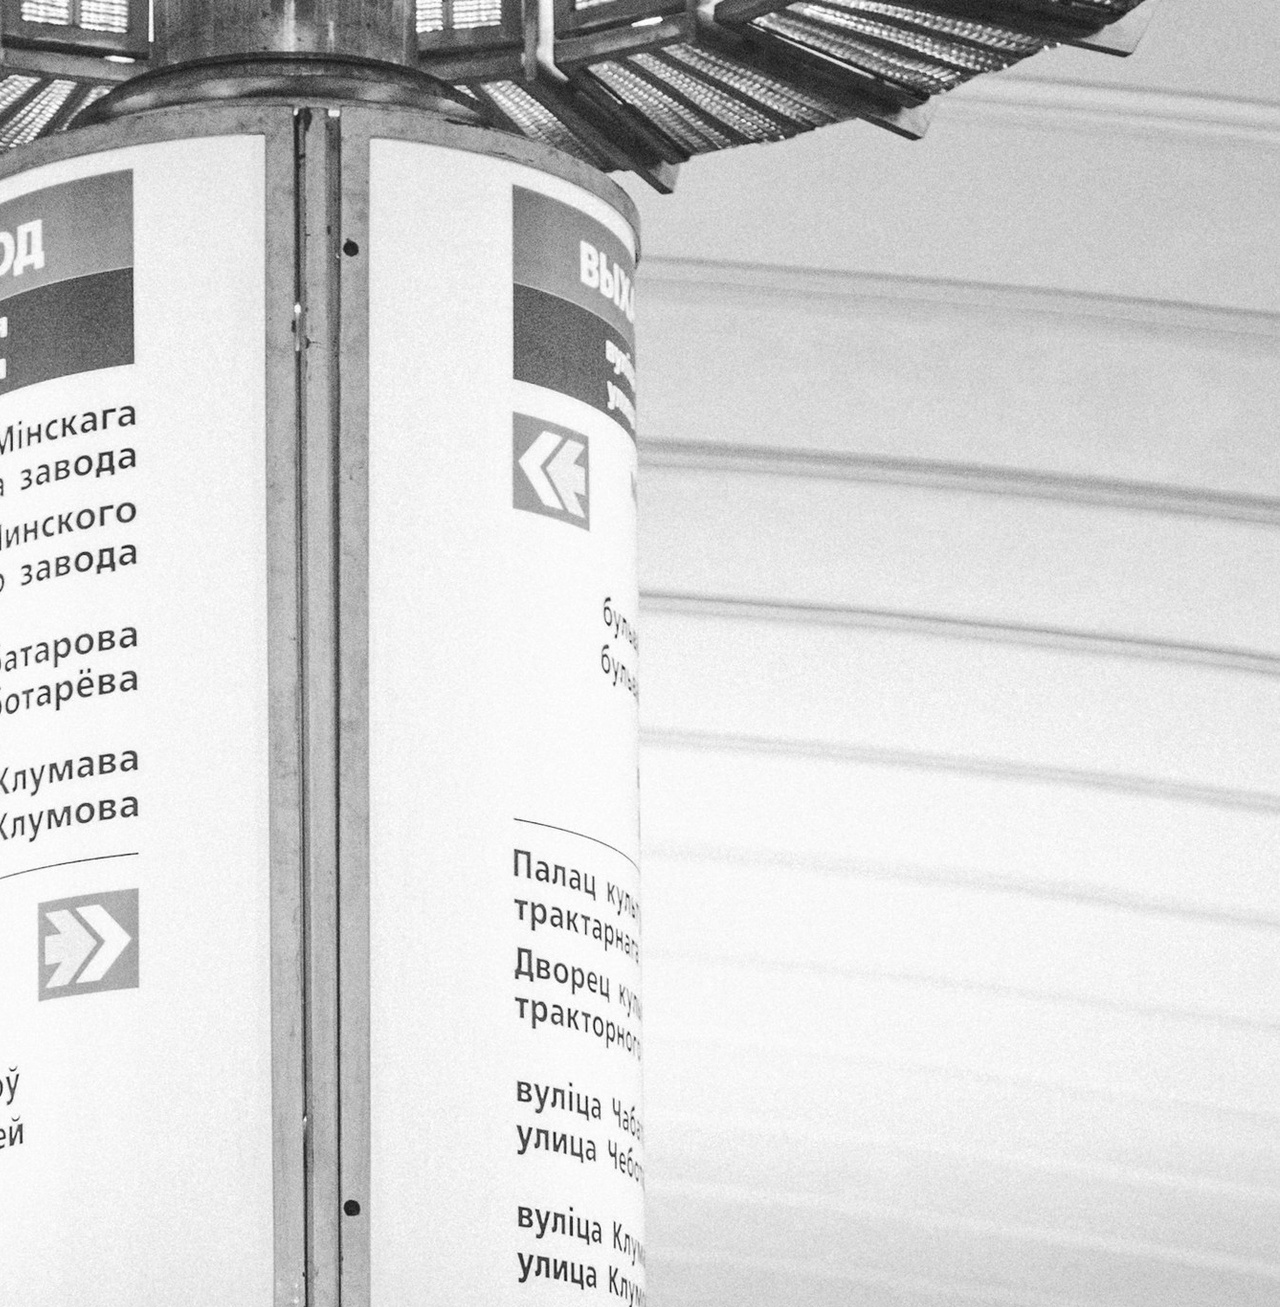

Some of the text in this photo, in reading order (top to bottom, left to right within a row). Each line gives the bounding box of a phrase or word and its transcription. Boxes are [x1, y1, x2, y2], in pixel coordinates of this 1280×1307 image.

[20, 446, 136, 490] завода
[20, 543, 138, 586] завода
[513, 848, 596, 901] Палац
[514, 946, 610, 1003] Дворец
[516, 1079, 601, 1121] вуліца
[516, 1124, 596, 1163] улица
[517, 1205, 602, 1245] вуліца
[517, 1252, 597, 1291] улица
